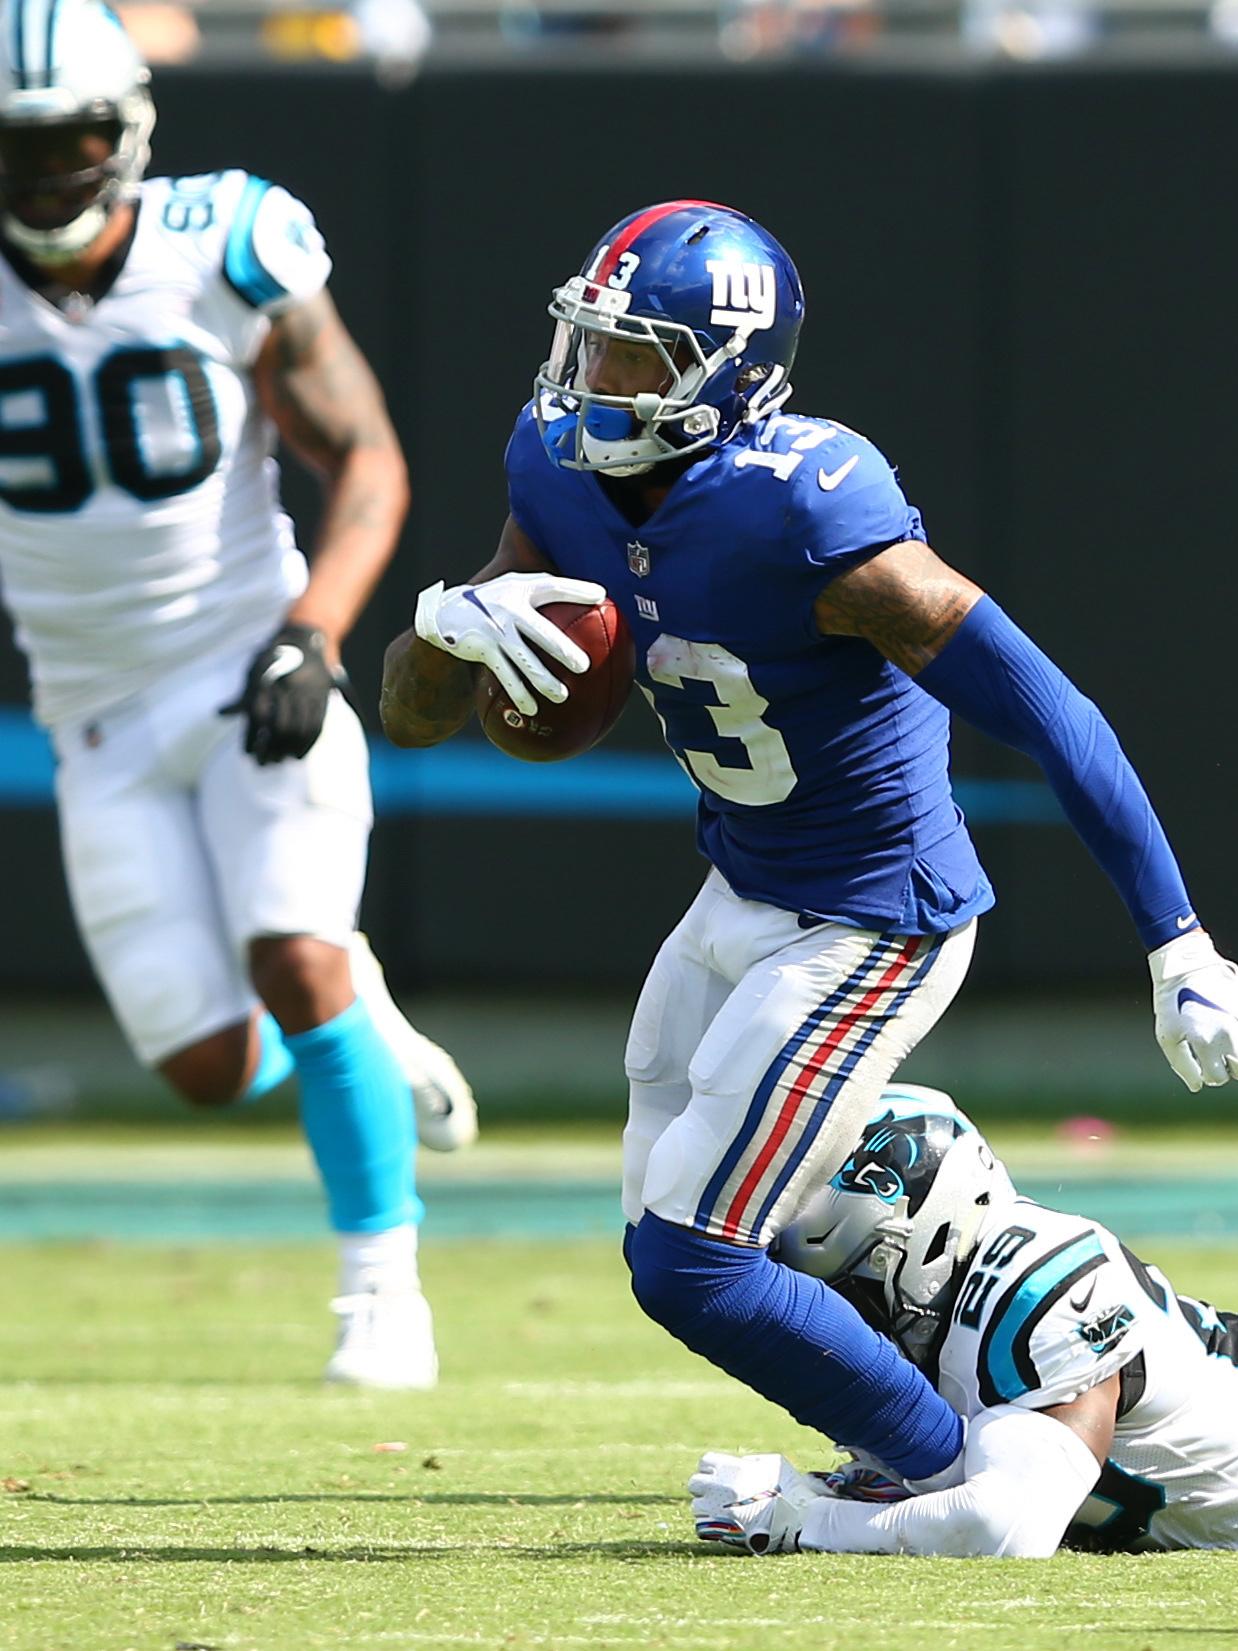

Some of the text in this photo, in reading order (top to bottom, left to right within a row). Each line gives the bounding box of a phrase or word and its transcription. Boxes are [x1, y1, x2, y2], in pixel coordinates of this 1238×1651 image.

[585, 244, 641, 290] 13
[0, 342, 222, 515] 90
[734, 414, 837, 481] 13
[634, 632, 798, 806] 3
[953, 1225, 1037, 1332] 29
